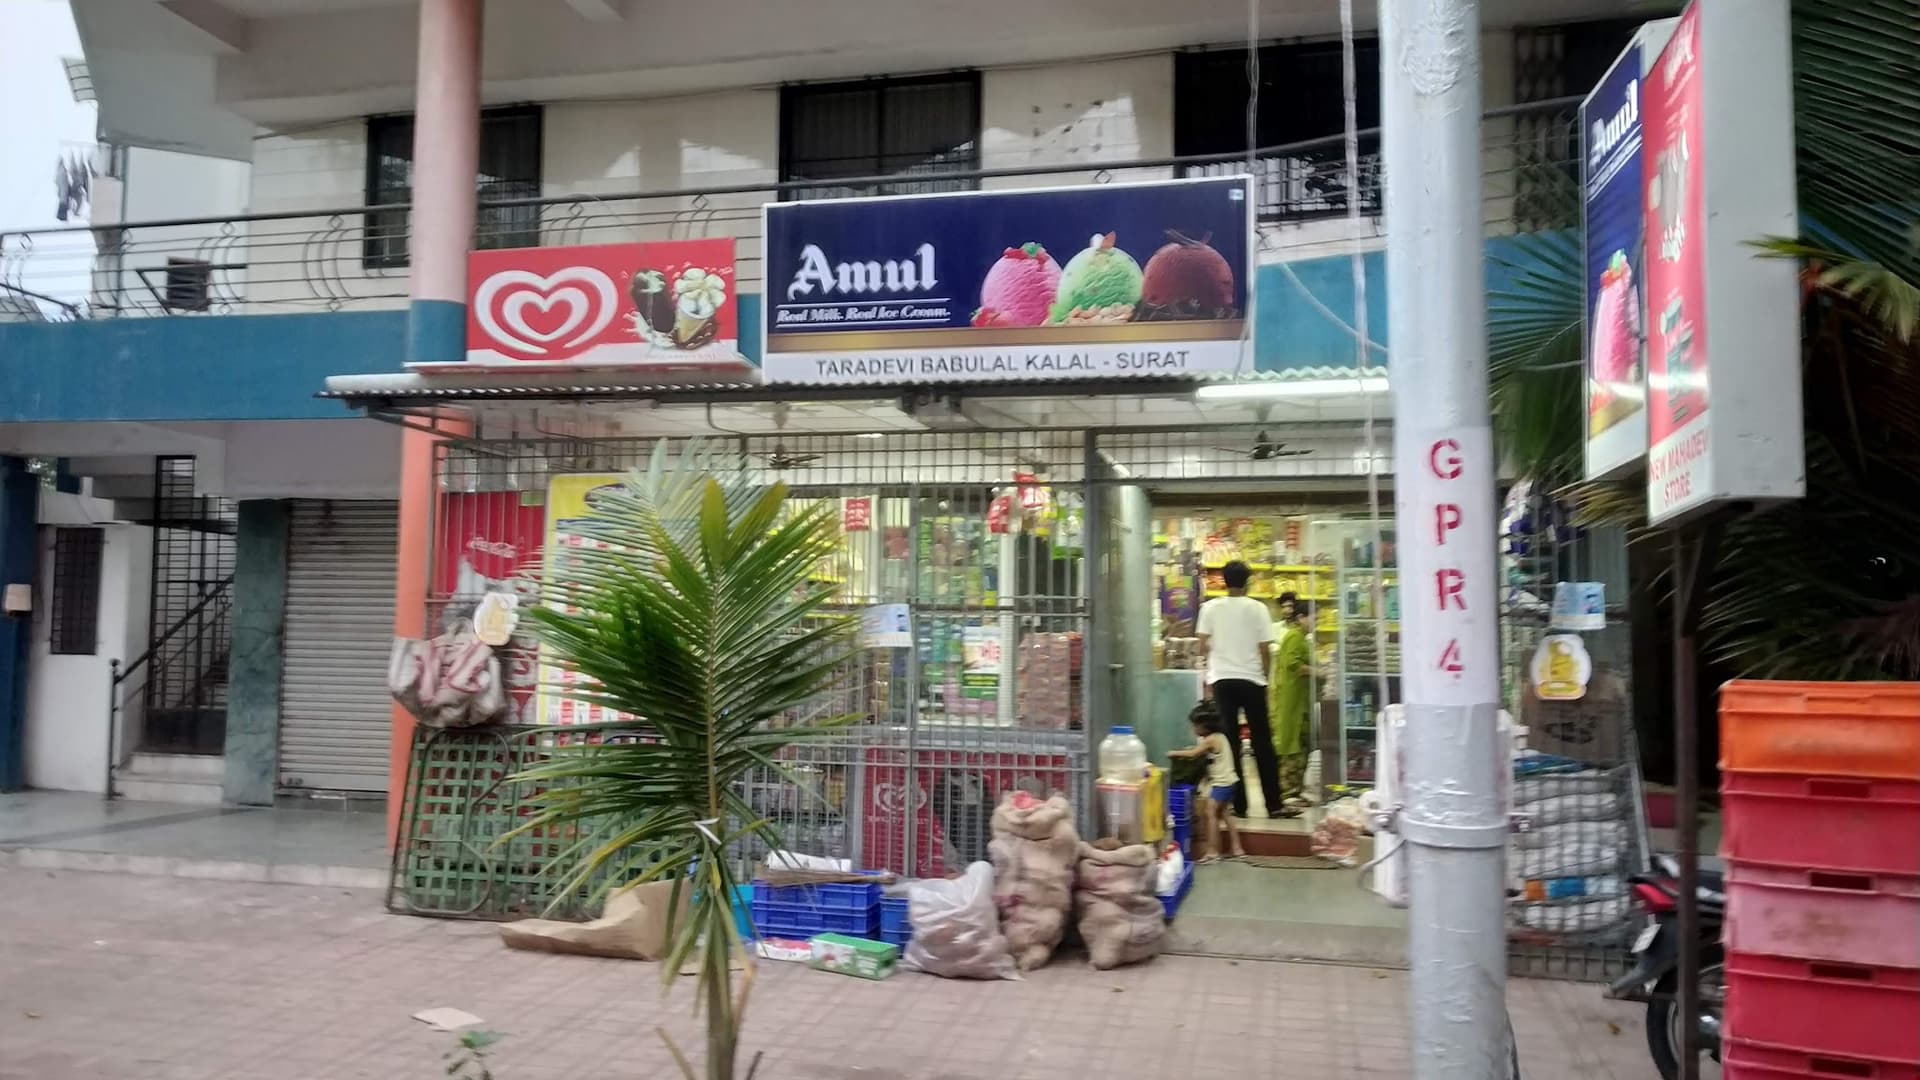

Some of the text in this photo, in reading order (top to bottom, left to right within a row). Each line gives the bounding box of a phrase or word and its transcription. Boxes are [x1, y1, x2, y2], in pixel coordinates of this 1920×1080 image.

[1588, 78, 1638, 176] Amul
[788, 242, 938, 301] Amul
[776, 305, 951, 323] Real Milk. Real Ice Cream.
[816, 358, 914, 377] TARADEVI
[921, 354, 1019, 374] BABULAL
[1025, 353, 1096, 371] KALAL
[1116, 350, 1189, 369] SURAT
[1664, 472, 1690, 507] STORE
